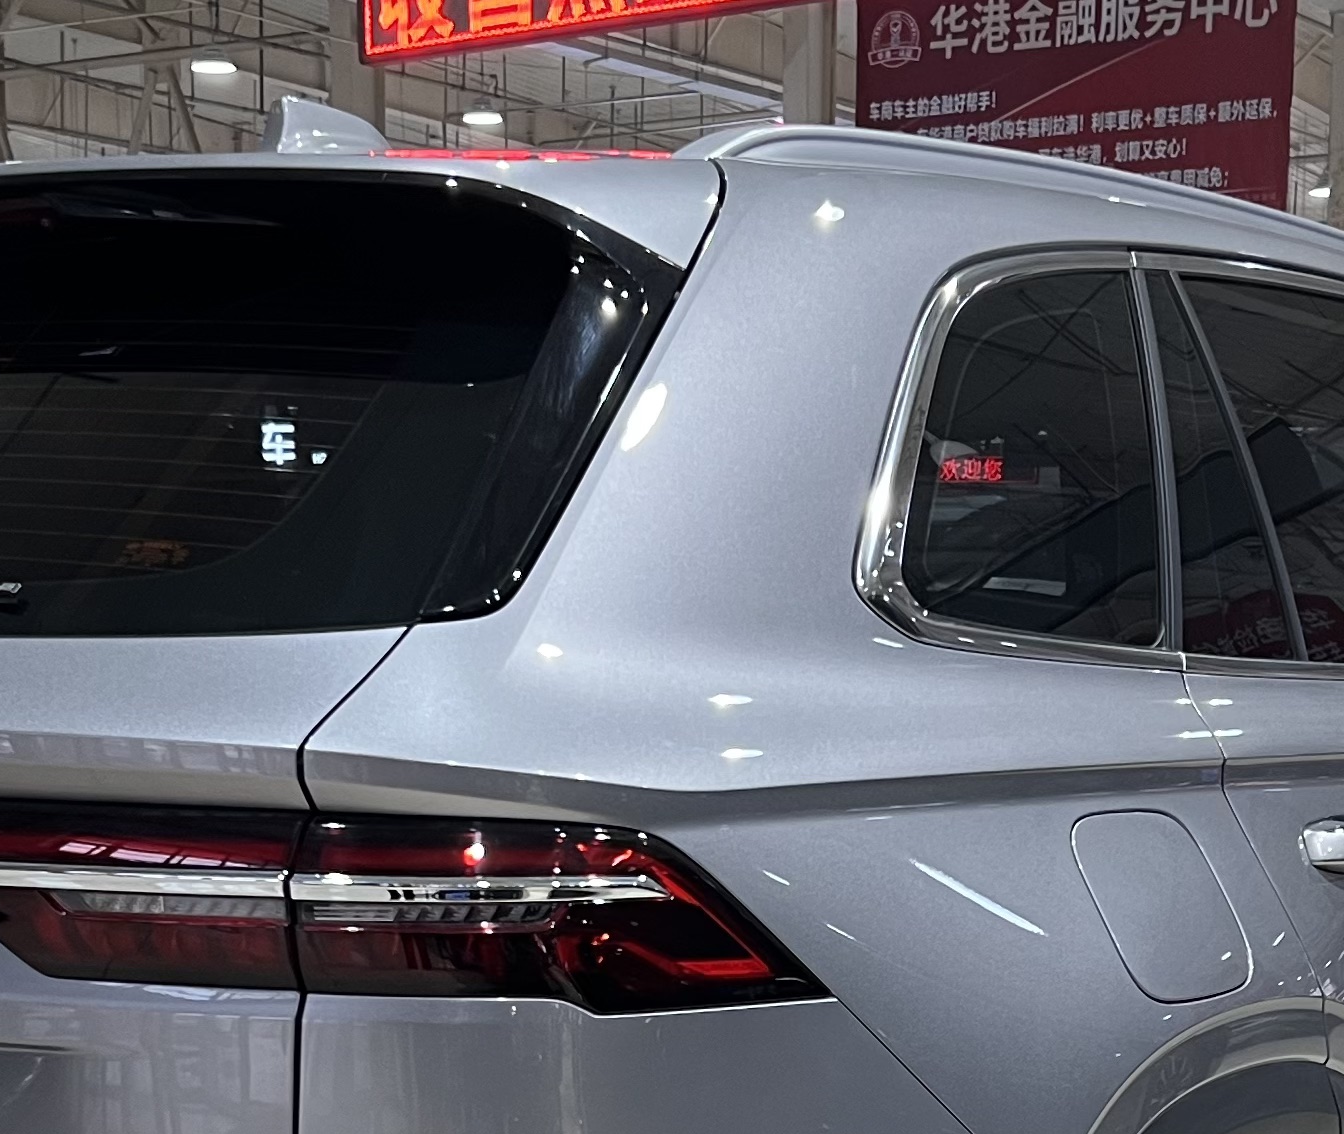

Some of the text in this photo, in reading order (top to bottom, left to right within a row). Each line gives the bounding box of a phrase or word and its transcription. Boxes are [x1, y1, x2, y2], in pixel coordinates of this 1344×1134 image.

[929, 0, 1278, 59] 华港金融服务中心
[939, 457, 1004, 483] 欢迎您
